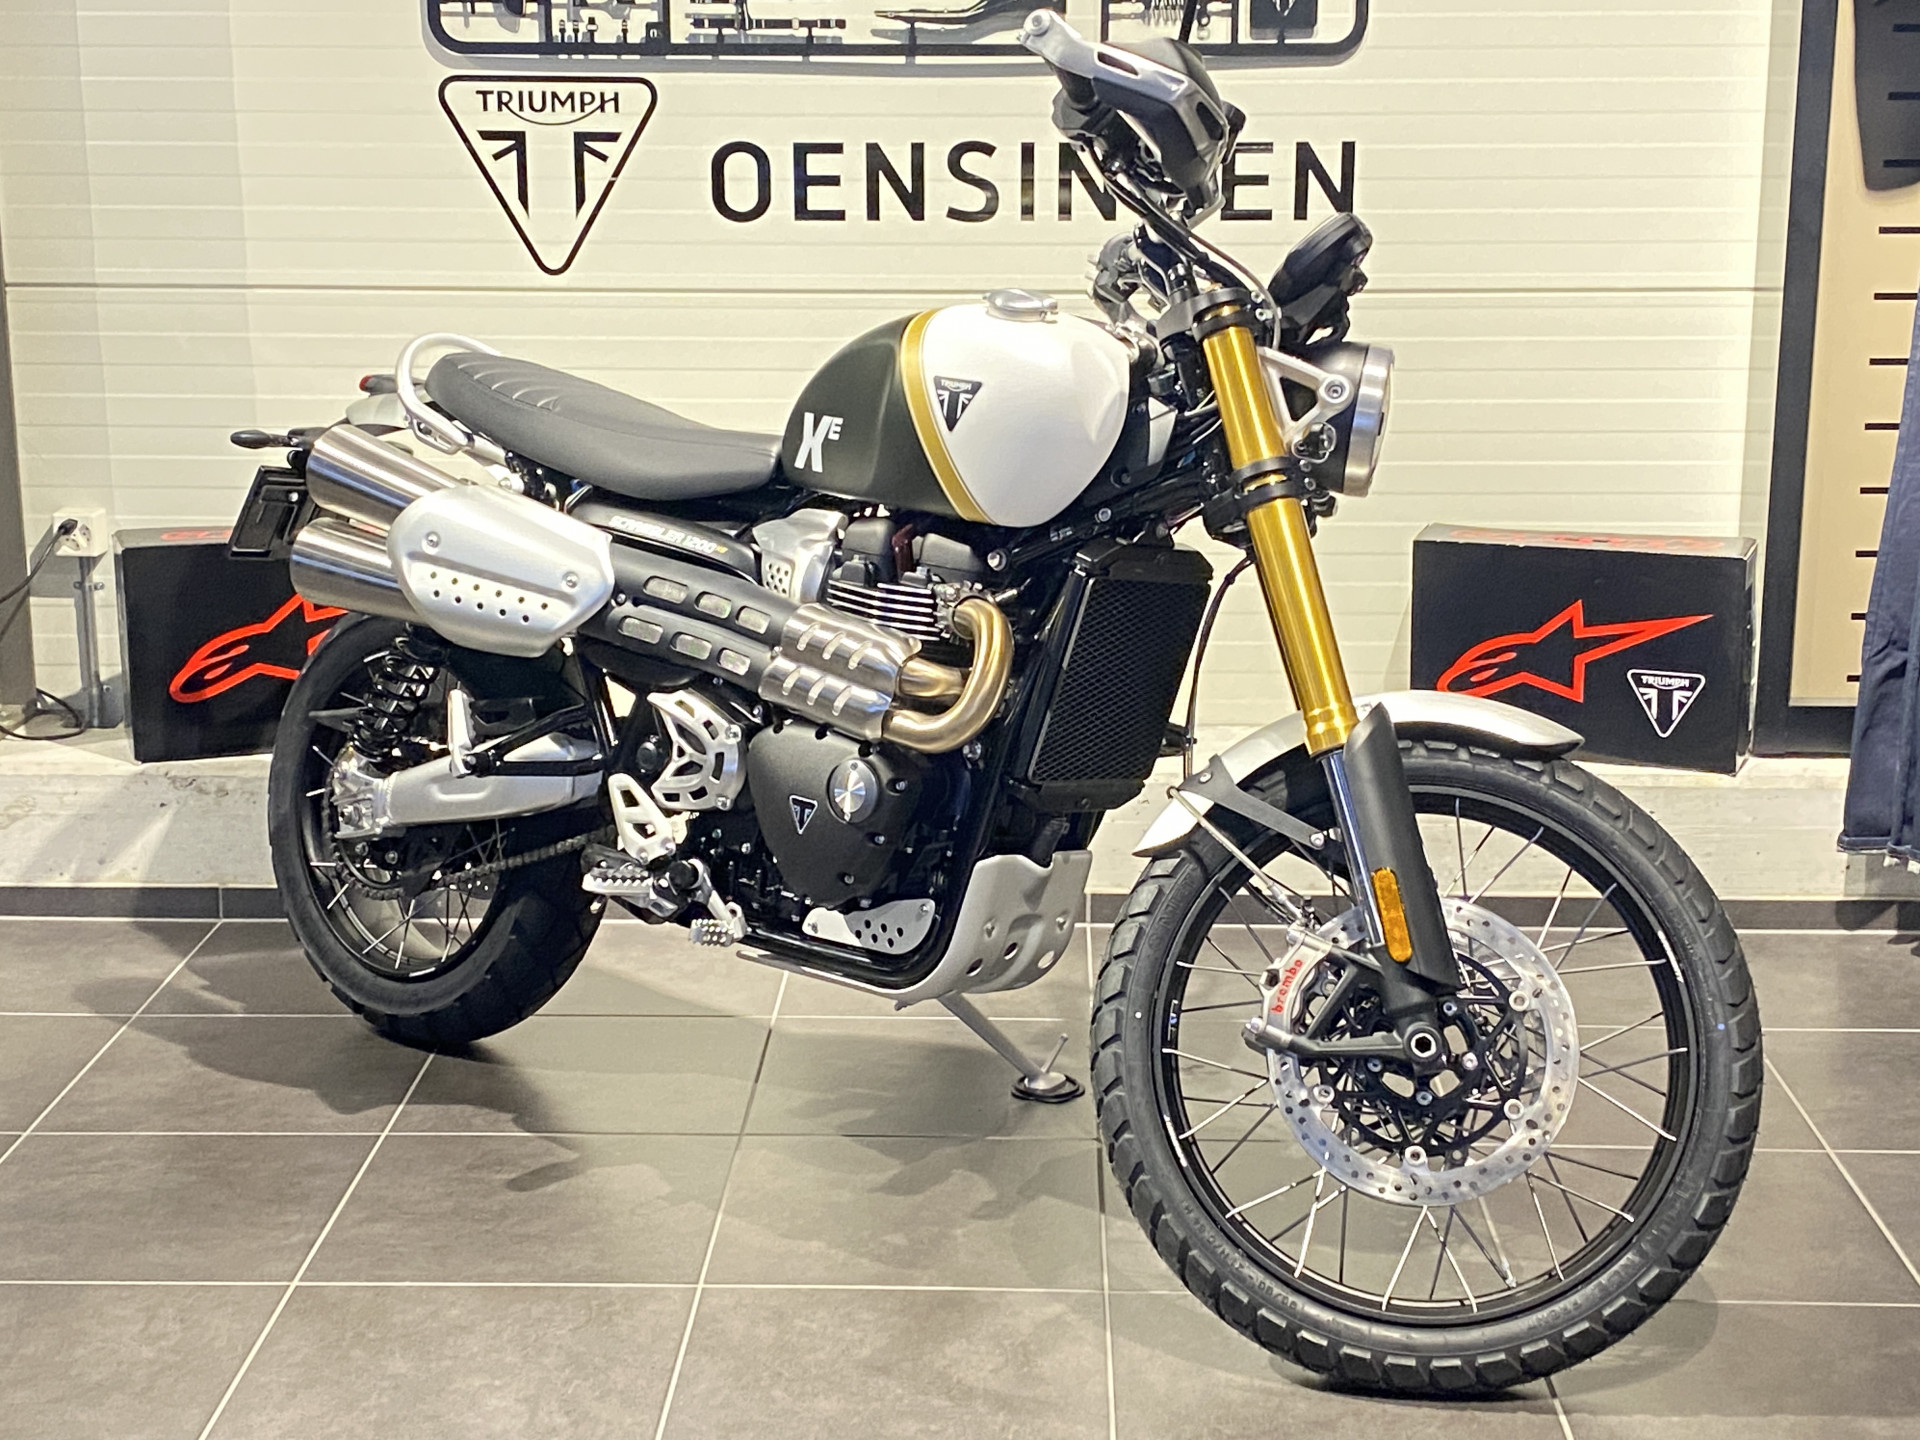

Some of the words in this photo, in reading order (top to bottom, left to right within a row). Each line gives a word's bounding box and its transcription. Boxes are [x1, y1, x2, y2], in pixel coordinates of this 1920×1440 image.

[475, 90, 620, 125] TRIUMPH
[711, 140, 1356, 223] OENSINEN
[1640, 675, 1690, 690] TRIUMPH
[1271, 959, 1303, 1013] brembo
